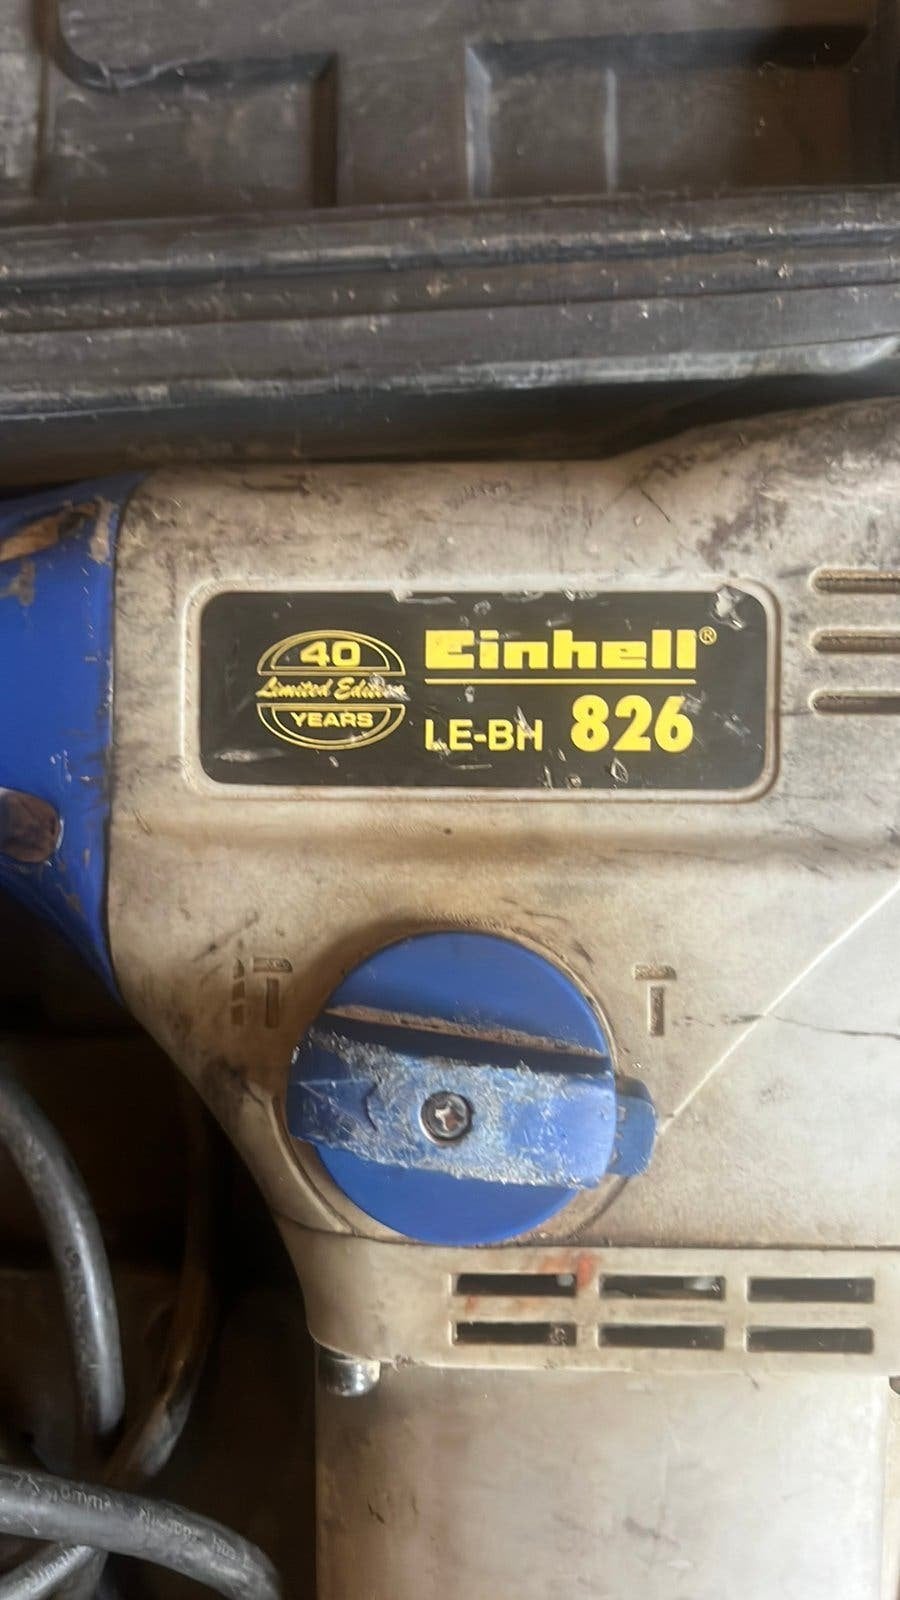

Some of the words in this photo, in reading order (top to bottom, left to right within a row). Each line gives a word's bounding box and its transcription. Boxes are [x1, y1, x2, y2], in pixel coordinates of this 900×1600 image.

[299, 640, 361, 667] 40
[256, 676, 333, 698] Limited
[290, 711, 373, 728] YEARS
[425, 719, 543, 752] LE-BH
[570, 694, 694, 753] 826
